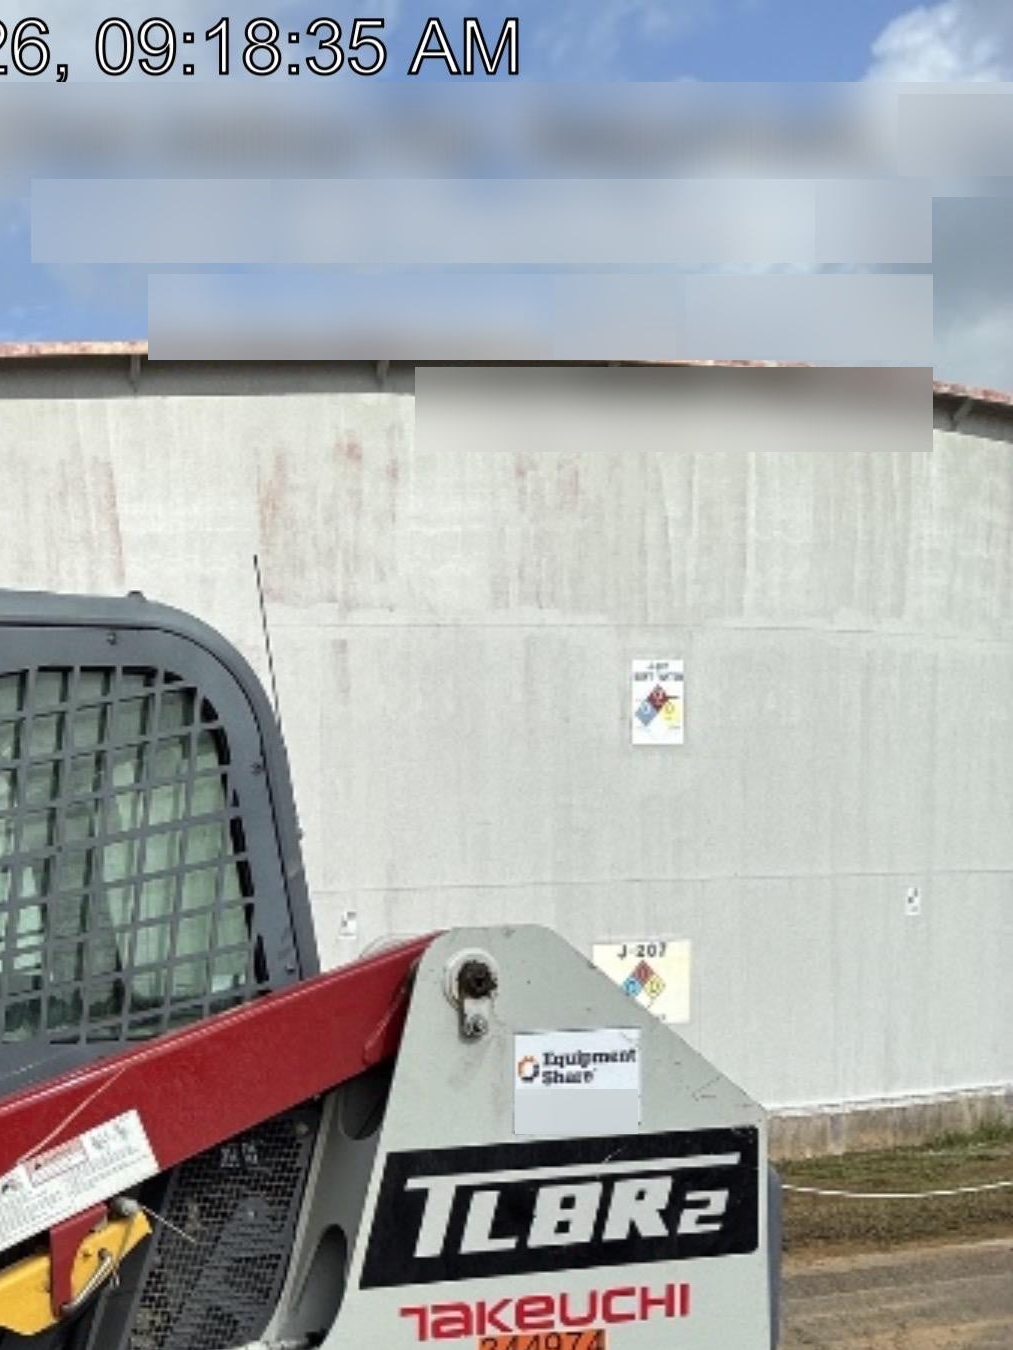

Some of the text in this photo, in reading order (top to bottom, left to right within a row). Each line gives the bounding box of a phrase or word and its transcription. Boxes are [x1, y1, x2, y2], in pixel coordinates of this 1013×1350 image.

[617, 942, 666, 959] J-207
[542, 1050, 636, 1068] Equipment
[541, 1070, 594, 1084] Share
[404, 1152, 741, 1258] TL8R2
